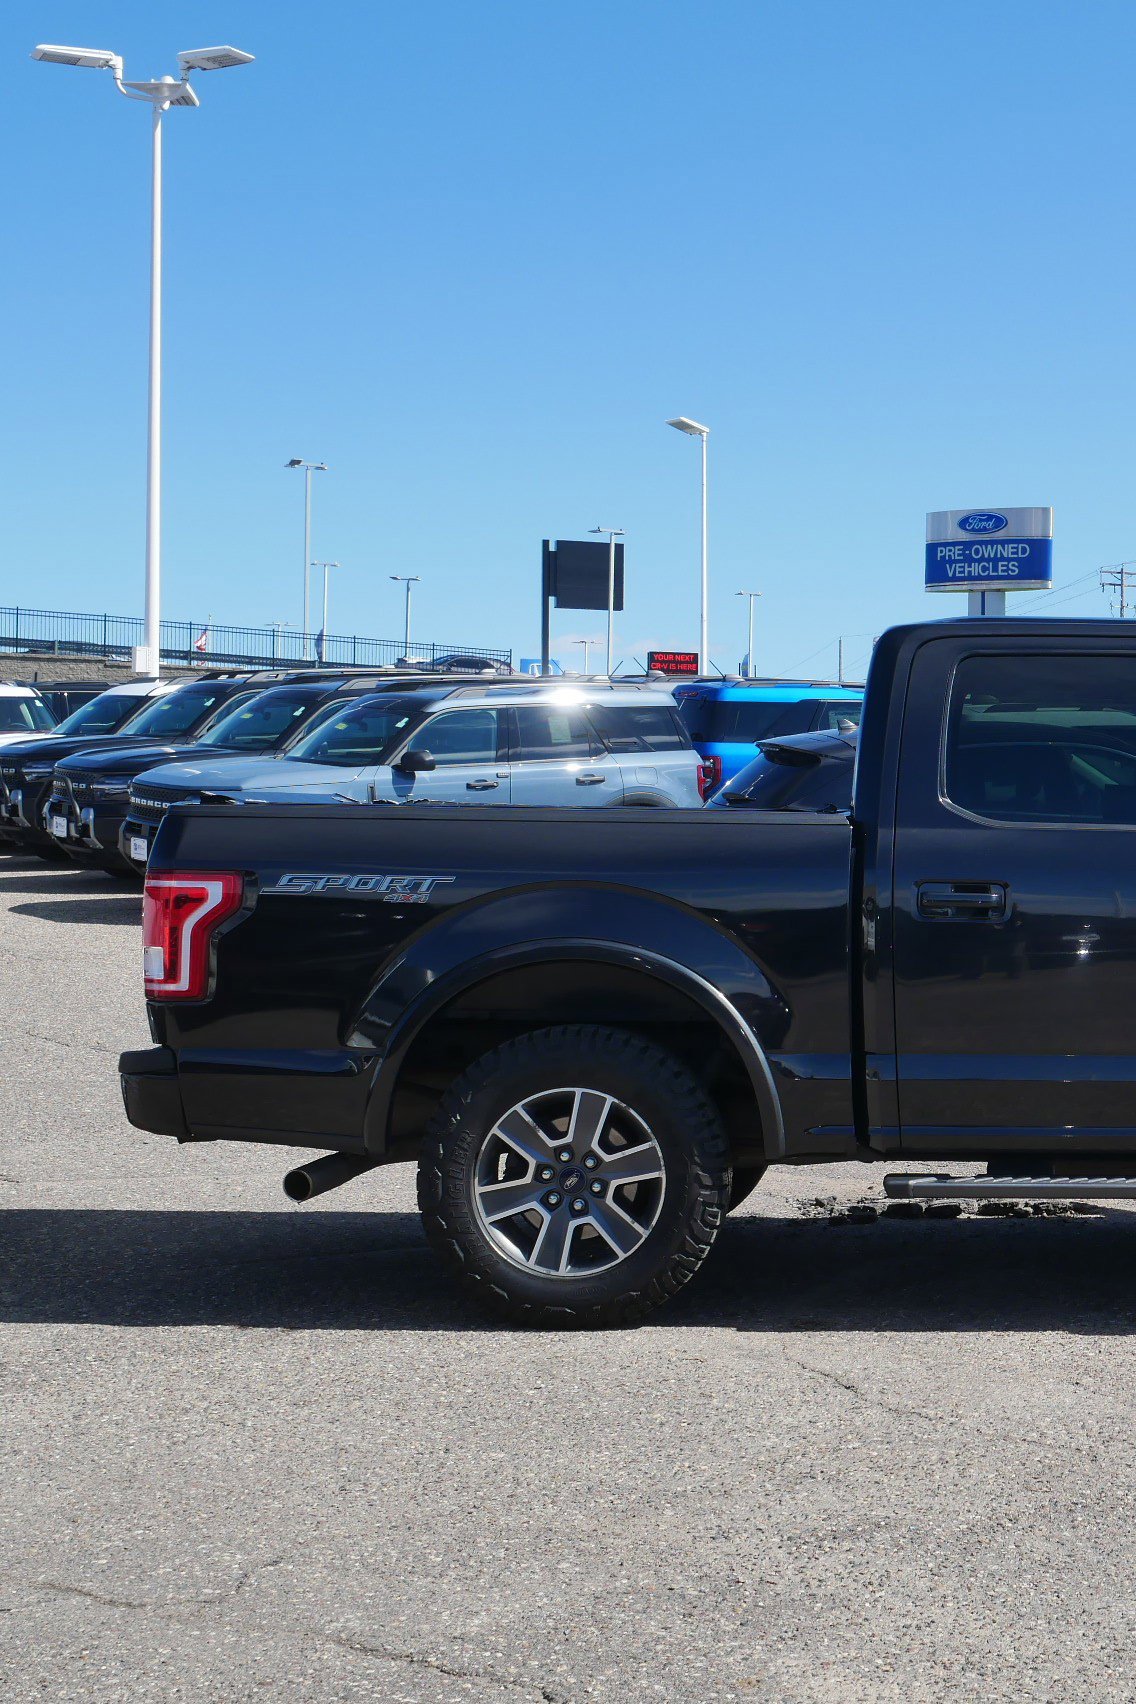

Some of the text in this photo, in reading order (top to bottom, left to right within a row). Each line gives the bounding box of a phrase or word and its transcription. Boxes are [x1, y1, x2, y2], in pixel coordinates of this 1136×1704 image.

[966, 515, 995, 530] Ford
[937, 544, 1030, 561] PRE-OWNED
[946, 561, 1019, 577] VEHICLES
[653, 653, 695, 662] YOUR NEXT
[650, 662, 668, 670] CR-V
[677, 663, 698, 671] HERE
[259, 873, 456, 895] SPORT
